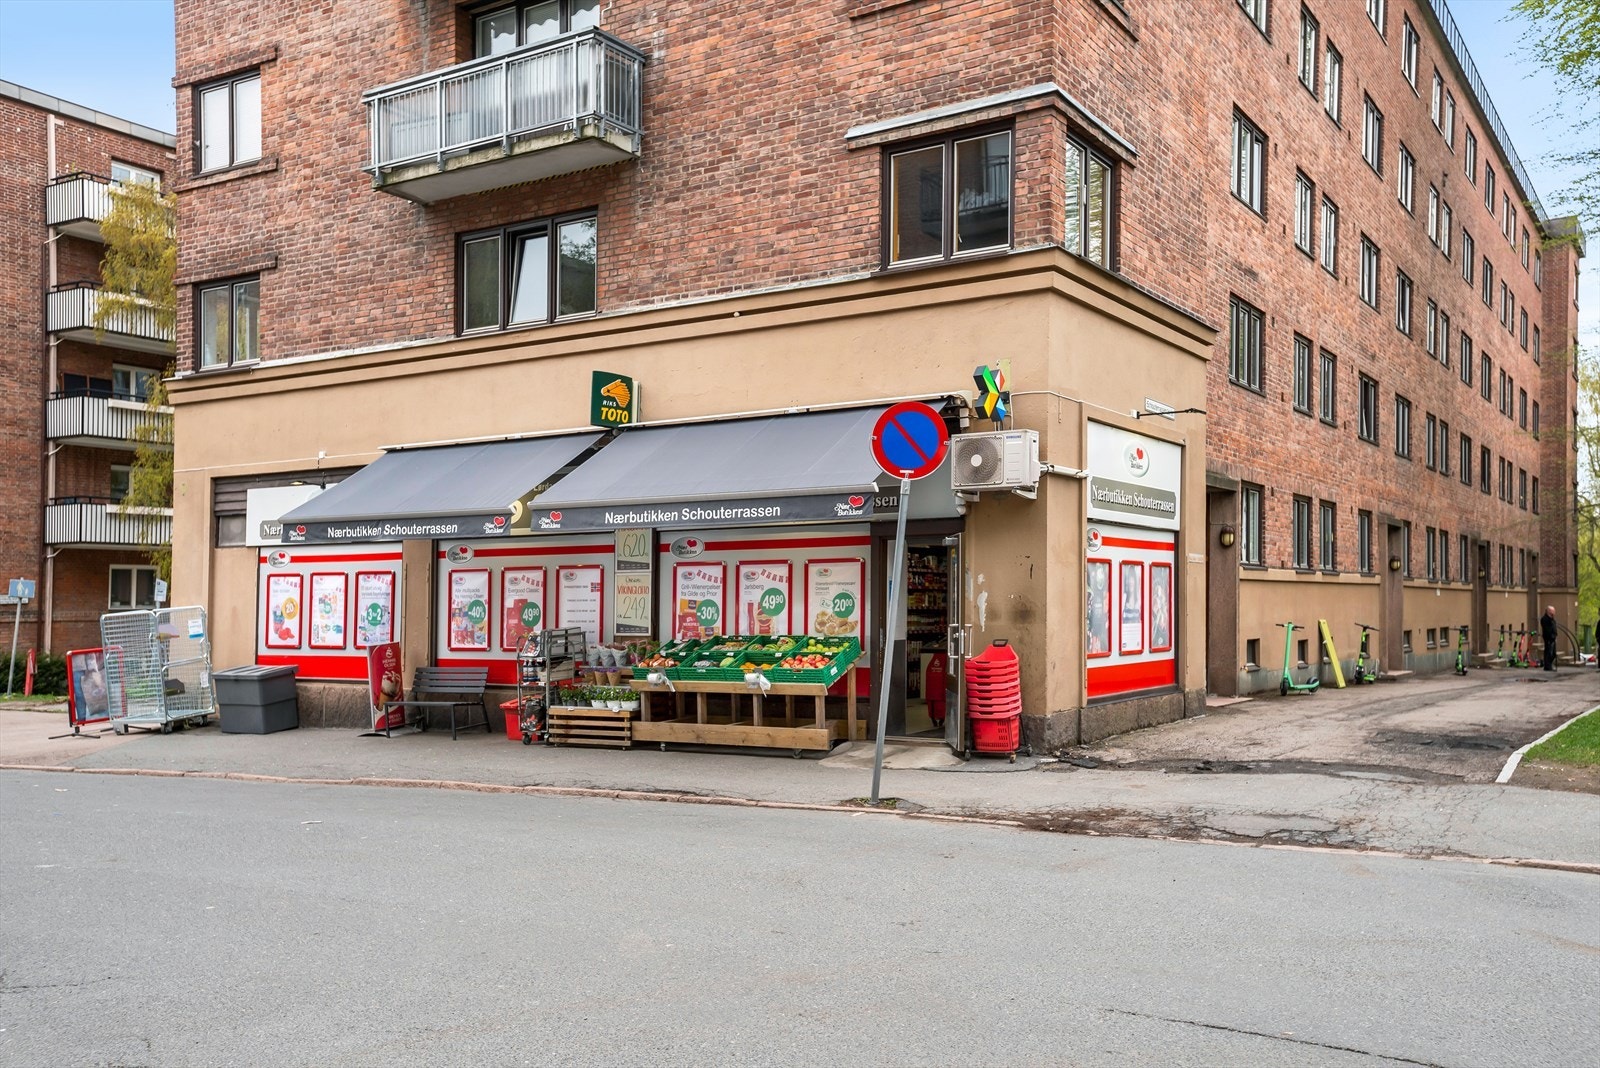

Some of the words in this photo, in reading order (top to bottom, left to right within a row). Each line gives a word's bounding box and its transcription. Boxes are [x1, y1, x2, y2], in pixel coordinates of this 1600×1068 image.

[601, 407, 629, 423] TOTO
[873, 496, 898, 507] sen
[1092, 484, 1132, 506] Nærbutikken
[1133, 492, 1175, 513] Schouterrassen
[605, 509, 678, 524] Nærbutikken
[681, 506, 781, 520] Schouterrassen
[327, 526, 382, 538] Nærbutikken
[383, 523, 458, 536] Schouterrassen
[623, 533, 646, 557] 620
[367, 610, 373, 621] 3
[377, 610, 382, 621] 2
[623, 596, 646, 619] 249
[697, 606, 718, 620] -30%
